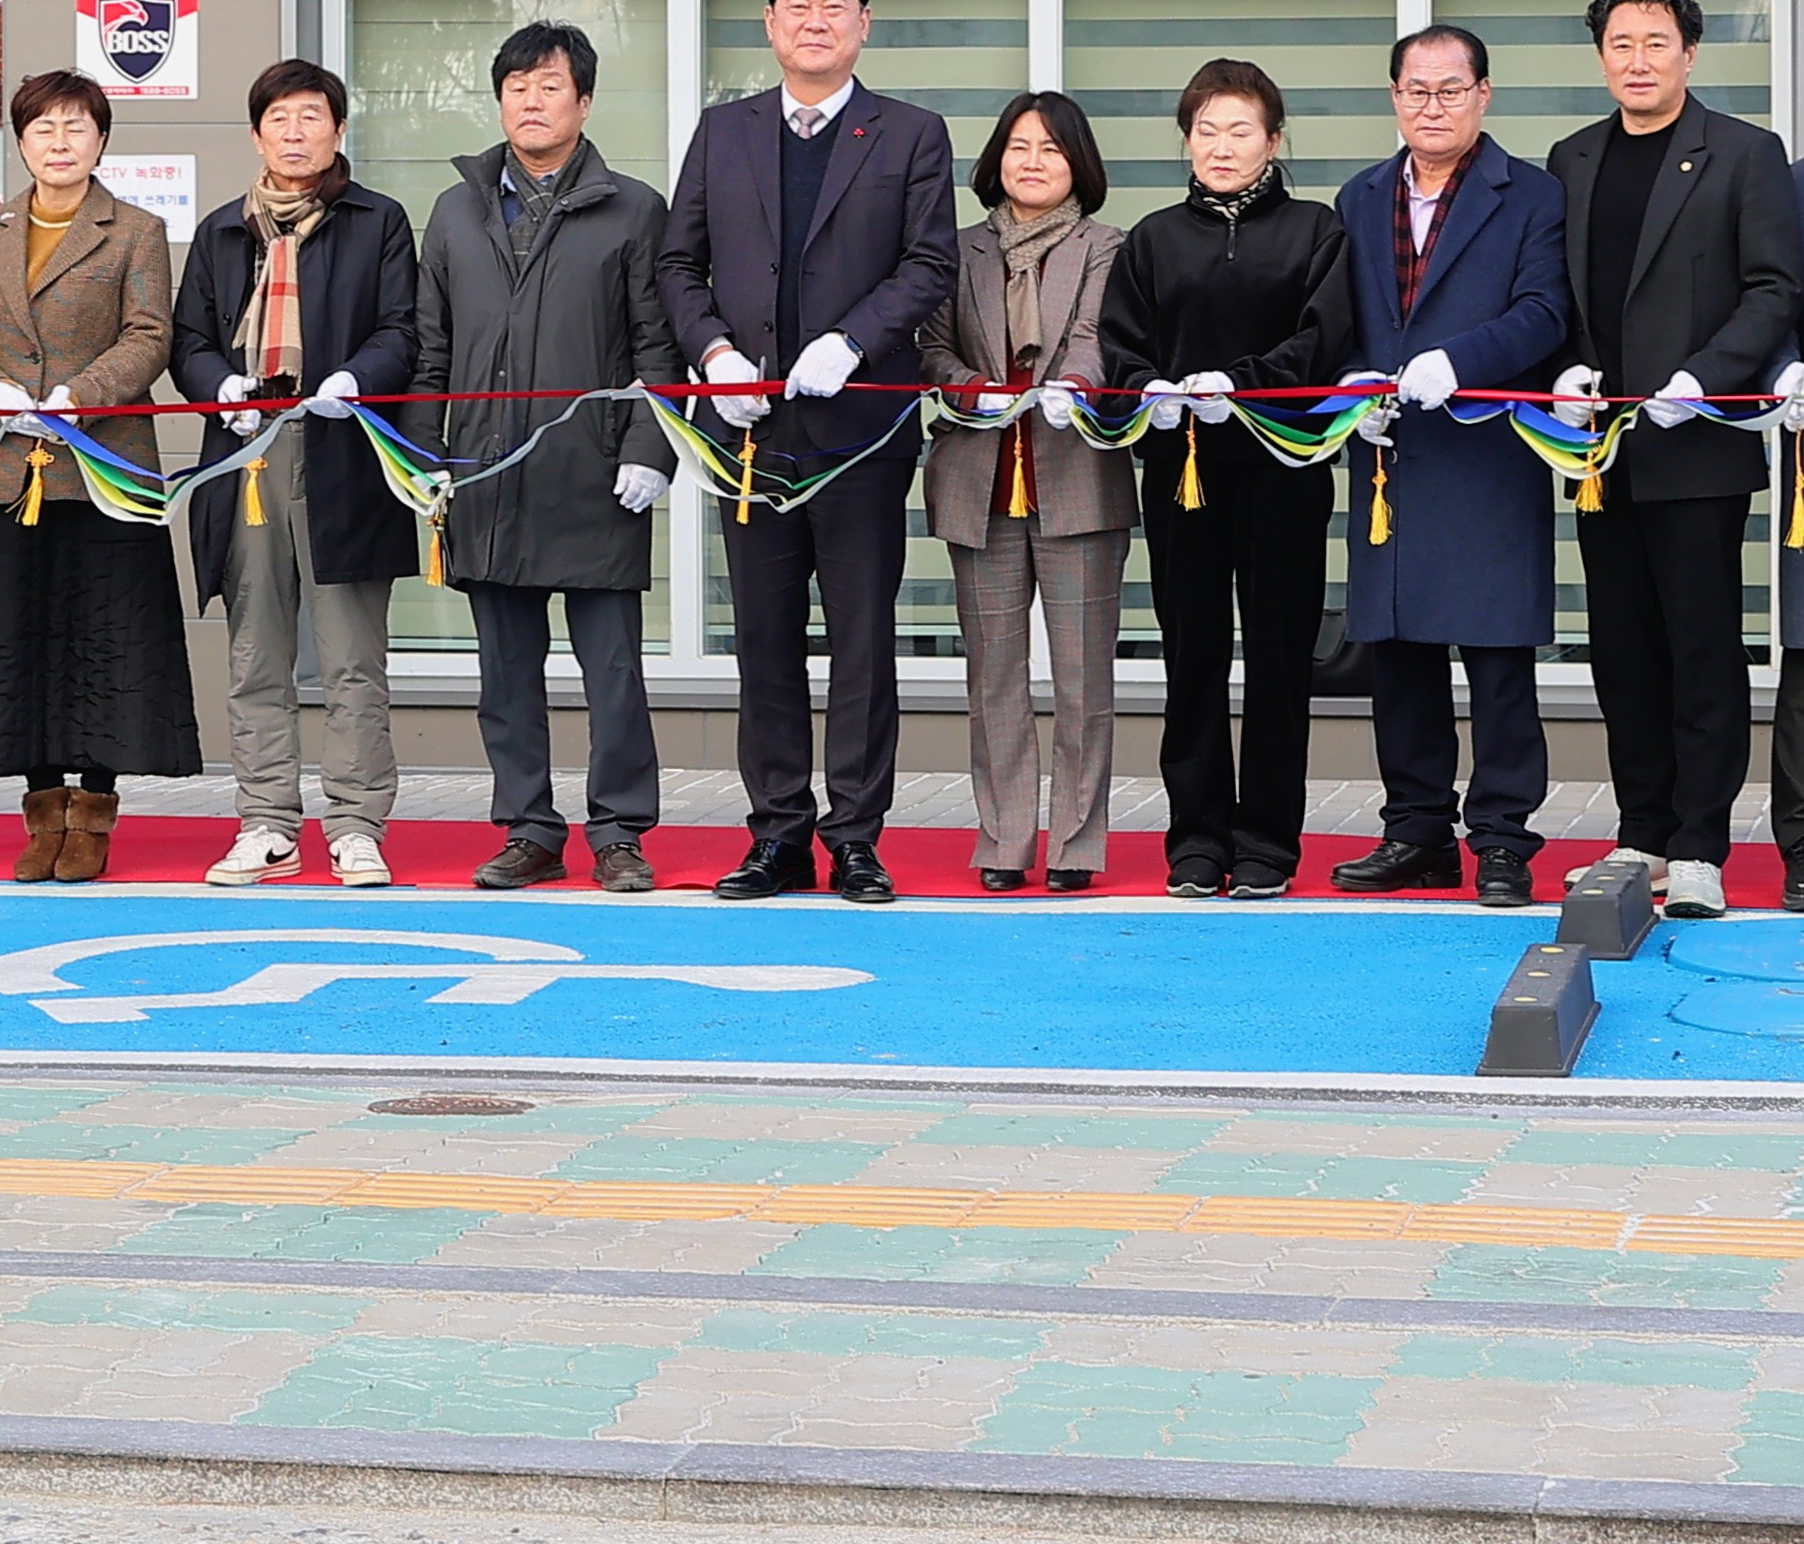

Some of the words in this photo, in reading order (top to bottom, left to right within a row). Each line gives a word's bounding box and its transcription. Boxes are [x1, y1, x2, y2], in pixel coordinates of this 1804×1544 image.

[108, 29, 169, 54] BOSS
[98, 166, 128, 180] CTV
[135, 166, 182, 180] 녹화중!
[144, 194, 188, 206] 쓰레기를
